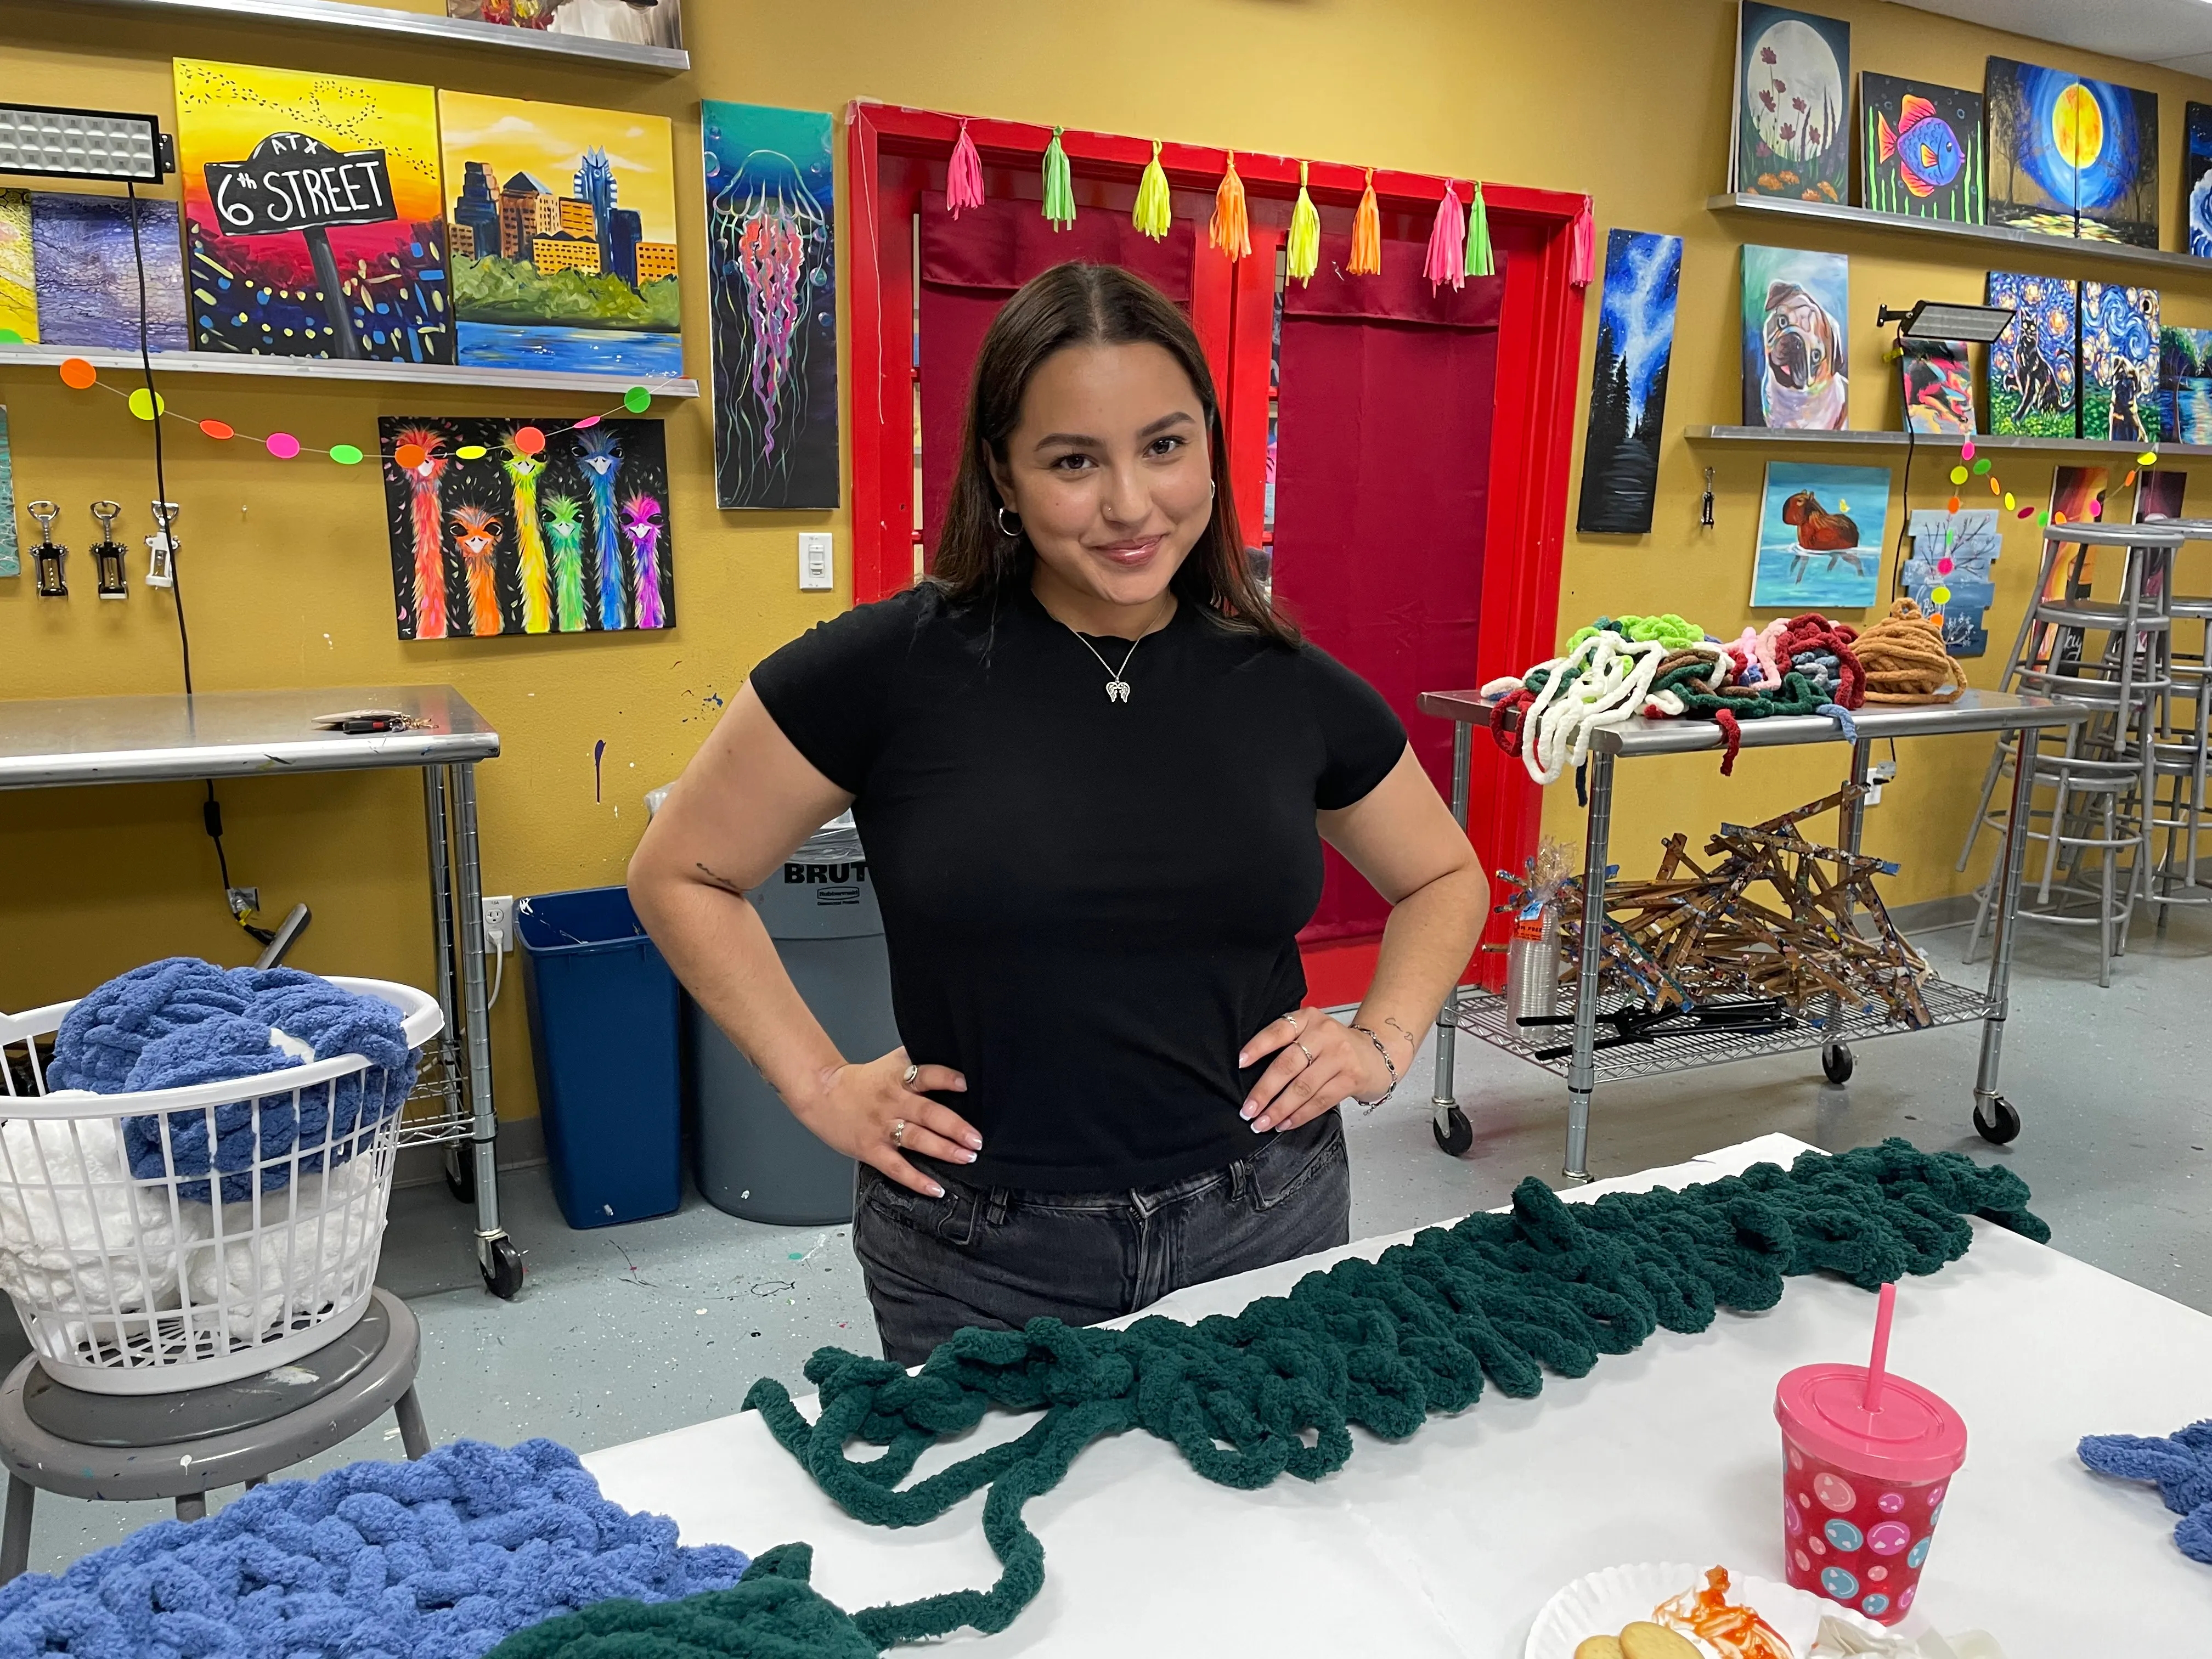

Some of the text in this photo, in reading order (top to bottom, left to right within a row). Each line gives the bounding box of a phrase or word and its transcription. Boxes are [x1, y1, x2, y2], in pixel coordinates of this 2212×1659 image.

[271, 134, 318, 155] ATX
[217, 161, 383, 226] 6th STREET
